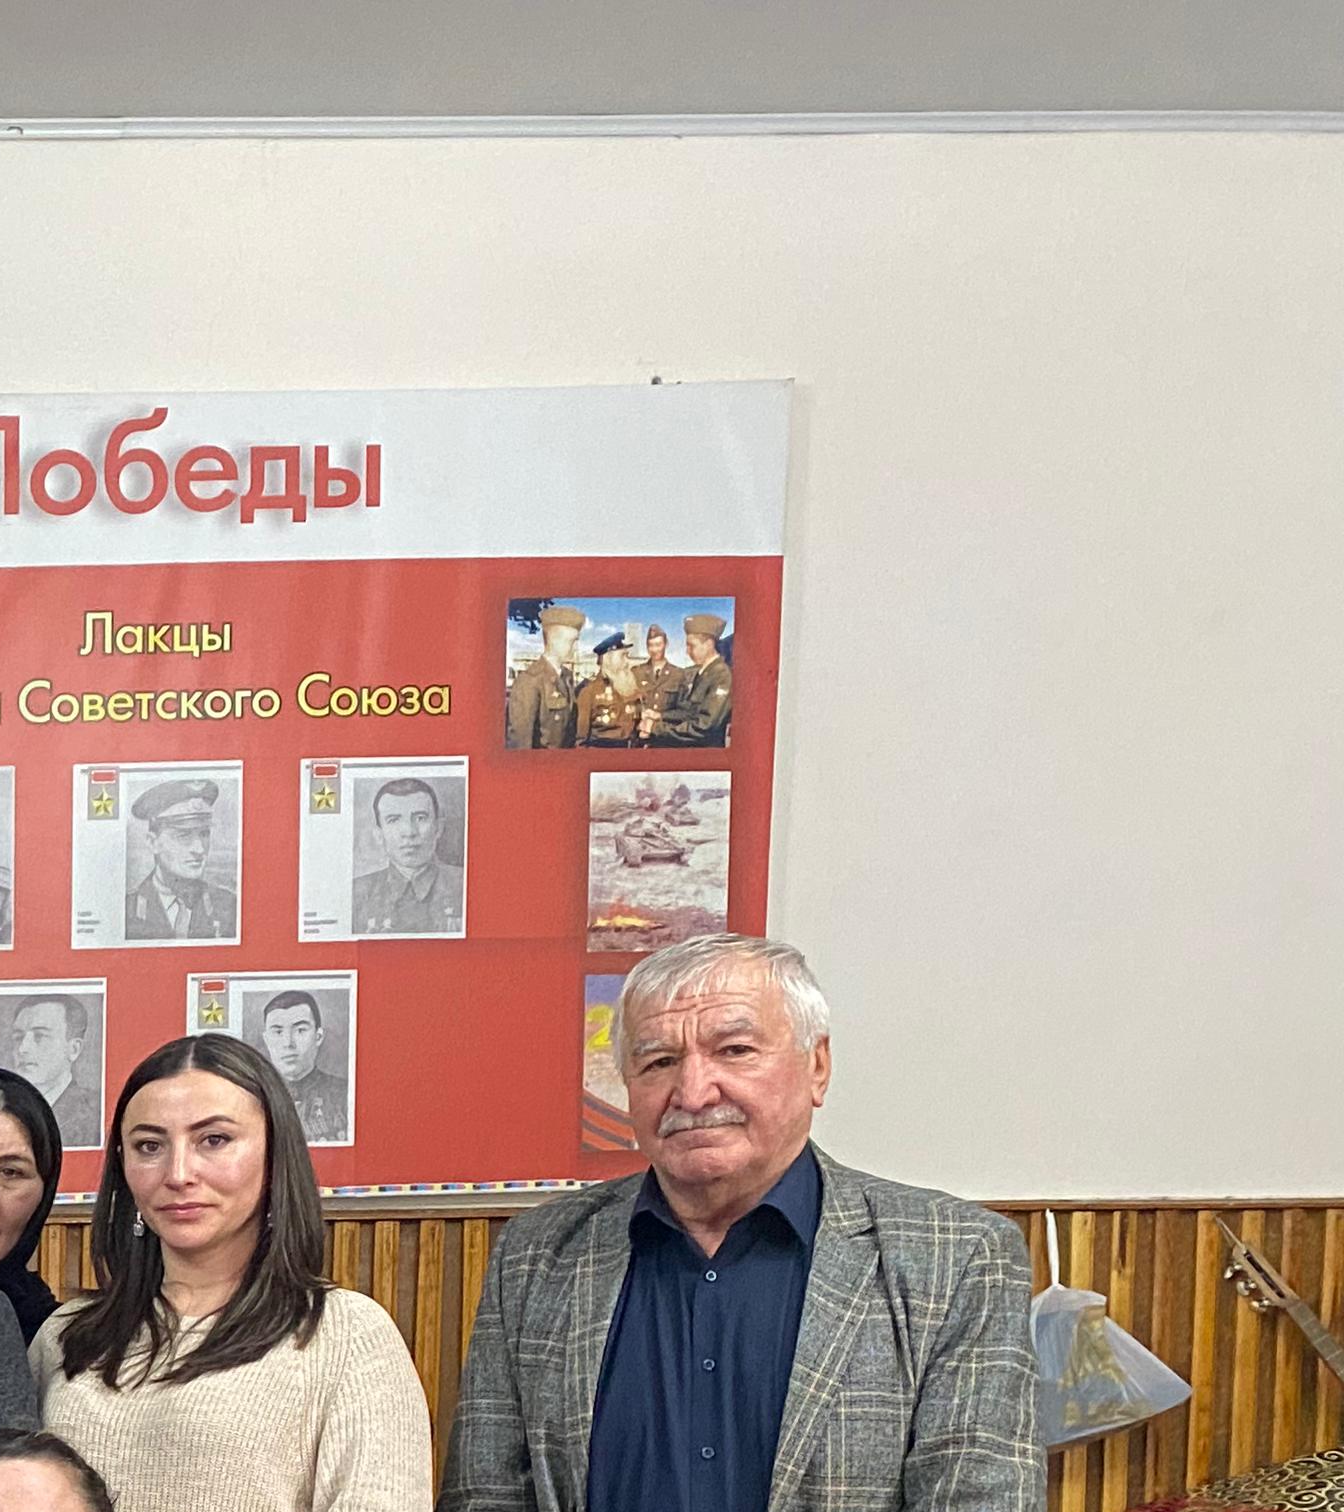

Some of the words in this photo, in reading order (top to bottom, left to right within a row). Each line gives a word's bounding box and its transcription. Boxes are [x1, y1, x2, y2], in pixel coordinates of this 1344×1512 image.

[79, 611, 231, 658] Лакцы
[18, 679, 280, 723] Советского
[297, 673, 449, 717] Союза
